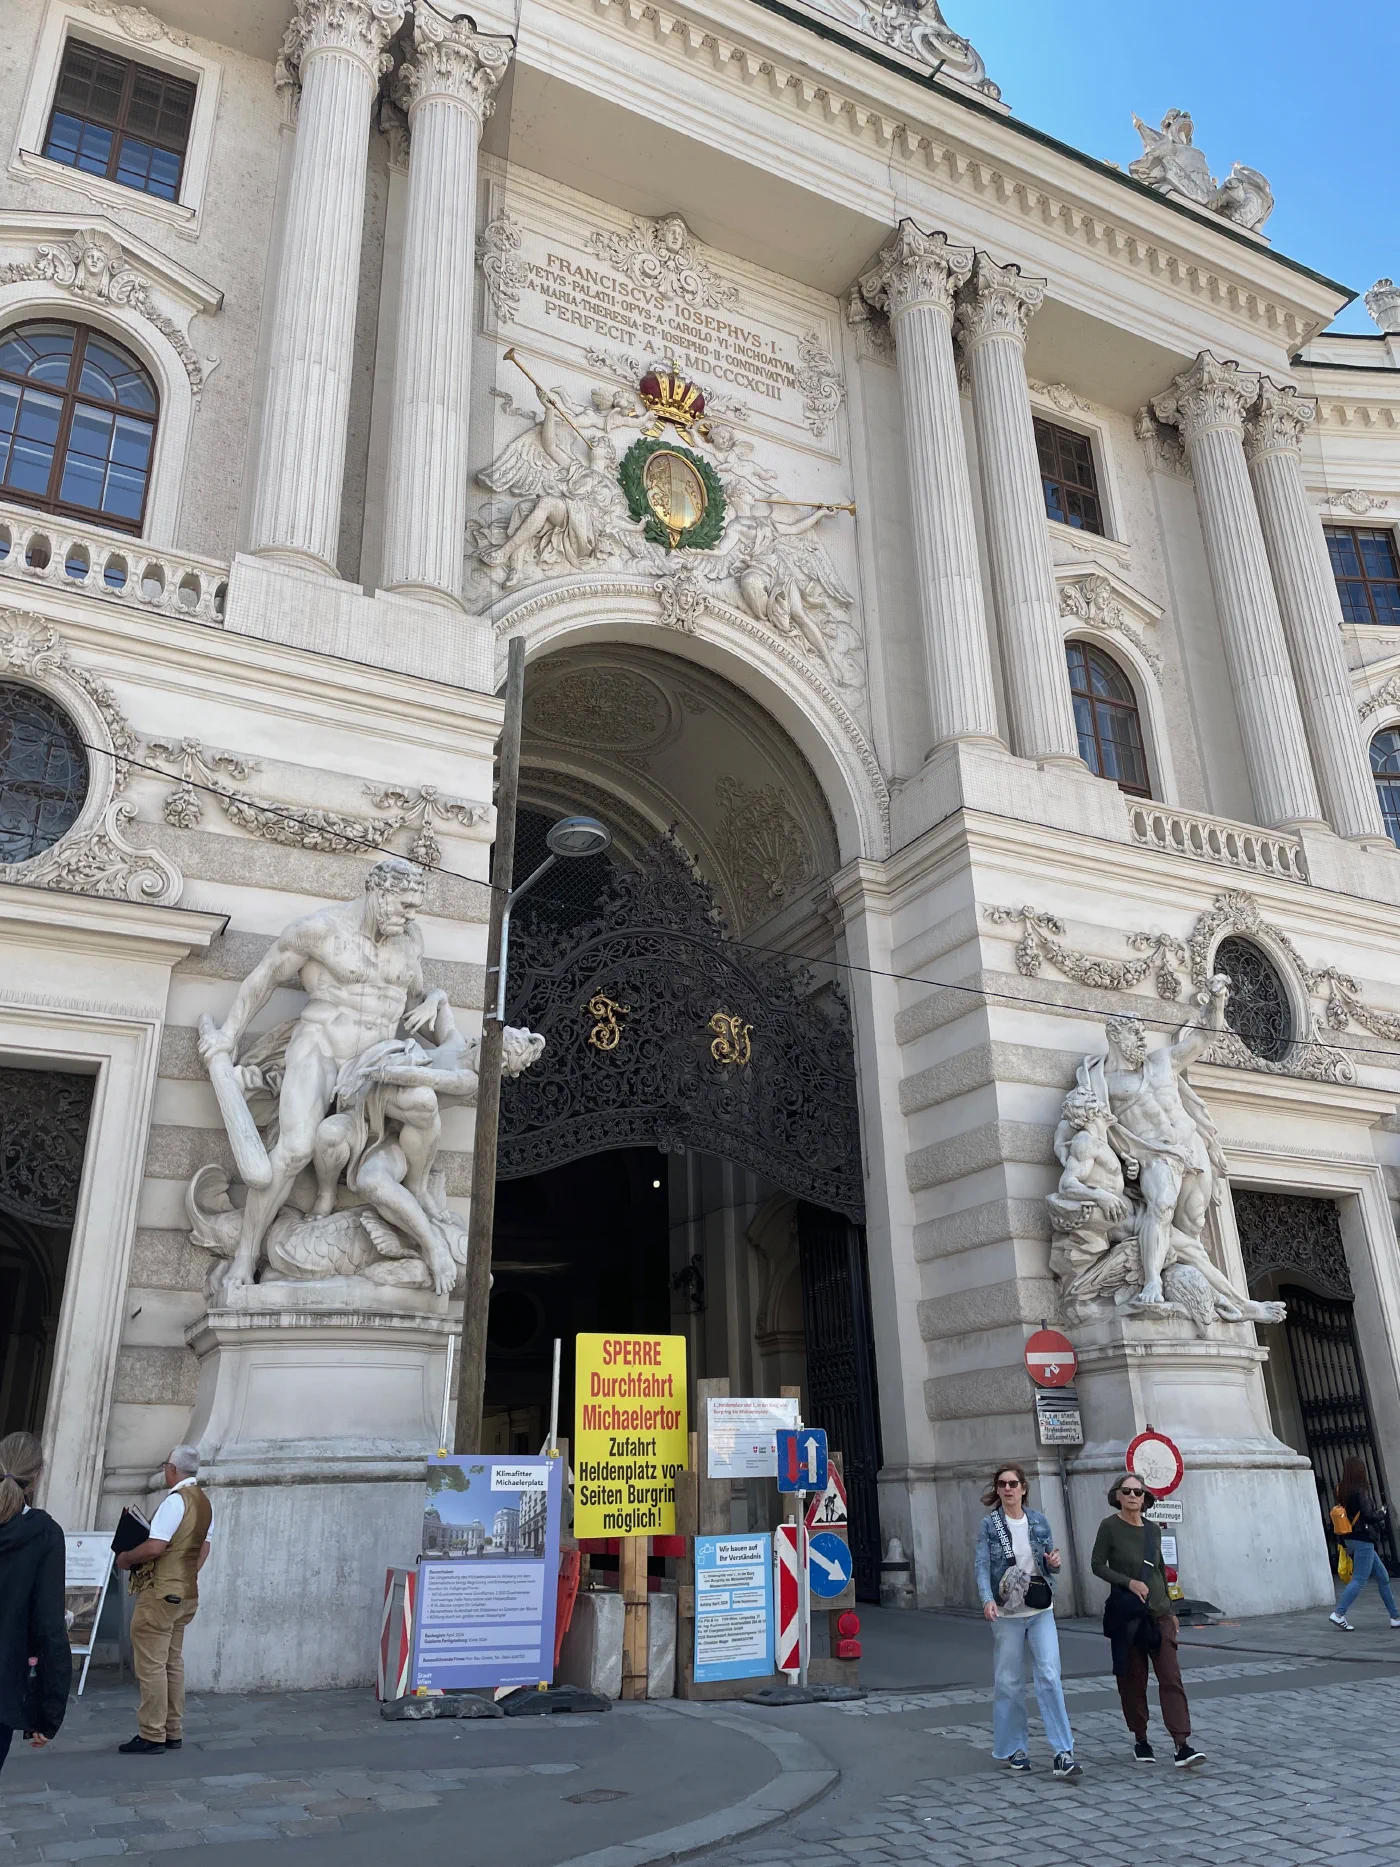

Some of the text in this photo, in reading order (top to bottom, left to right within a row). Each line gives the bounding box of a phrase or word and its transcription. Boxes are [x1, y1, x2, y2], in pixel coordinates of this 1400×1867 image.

[527, 263, 567, 287] VETVS
[621, 300, 652, 320] OPVS
[668, 318, 712, 343] CAROLO
[547, 253, 665, 311] FRANCISCVS
[675, 303, 762, 348] IOSEPHVS
[540, 282, 578, 308] MARIA
[581, 298, 639, 331] THERESIA
[642, 322, 658, 337] ET
[661, 329, 709, 356] IOSEPHO
[545, 300, 637, 346] PERFECIT
[602, 1339, 662, 1366] SPERRE
[590, 1371, 674, 1398] Durchfahrt
[582, 1404, 681, 1431] Michaelertor
[608, 1437, 657, 1457] Zufahrt
[496, 1479, 544, 1487] Michaelerplatz
[579, 1461, 657, 1484] Heldenplatz
[580, 1483, 676, 1508] Seiten Burgrin
[728, 1553, 761, 1561] Verständnis
